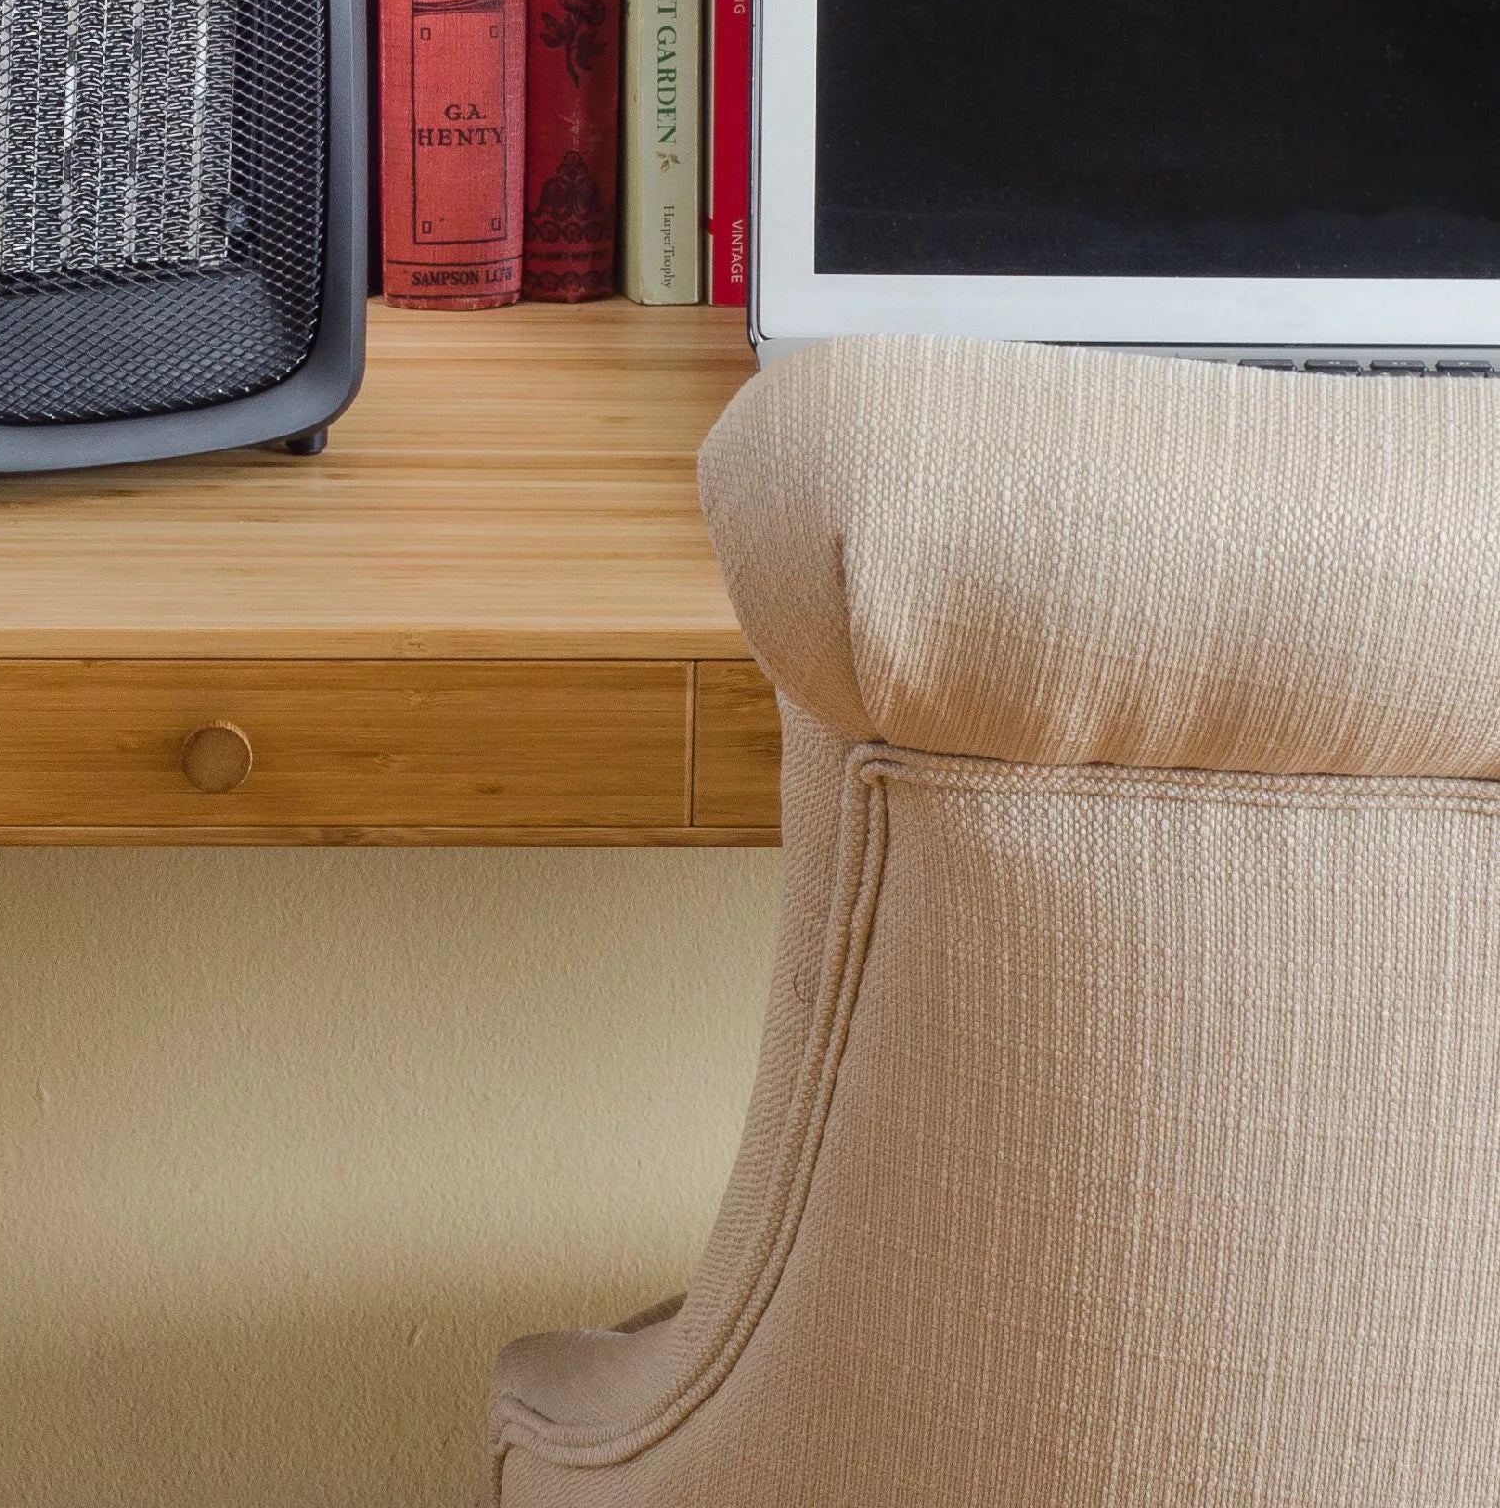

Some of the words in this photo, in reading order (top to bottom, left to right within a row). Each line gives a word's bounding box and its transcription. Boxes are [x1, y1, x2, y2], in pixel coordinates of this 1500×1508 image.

[656, 25, 677, 144] GARDEN
[444, 104, 487, 120] G.A.
[417, 127, 504, 146] HENTY
[730, 220, 744, 283] VINTAGE
[412, 270, 479, 286] SAMPSON
